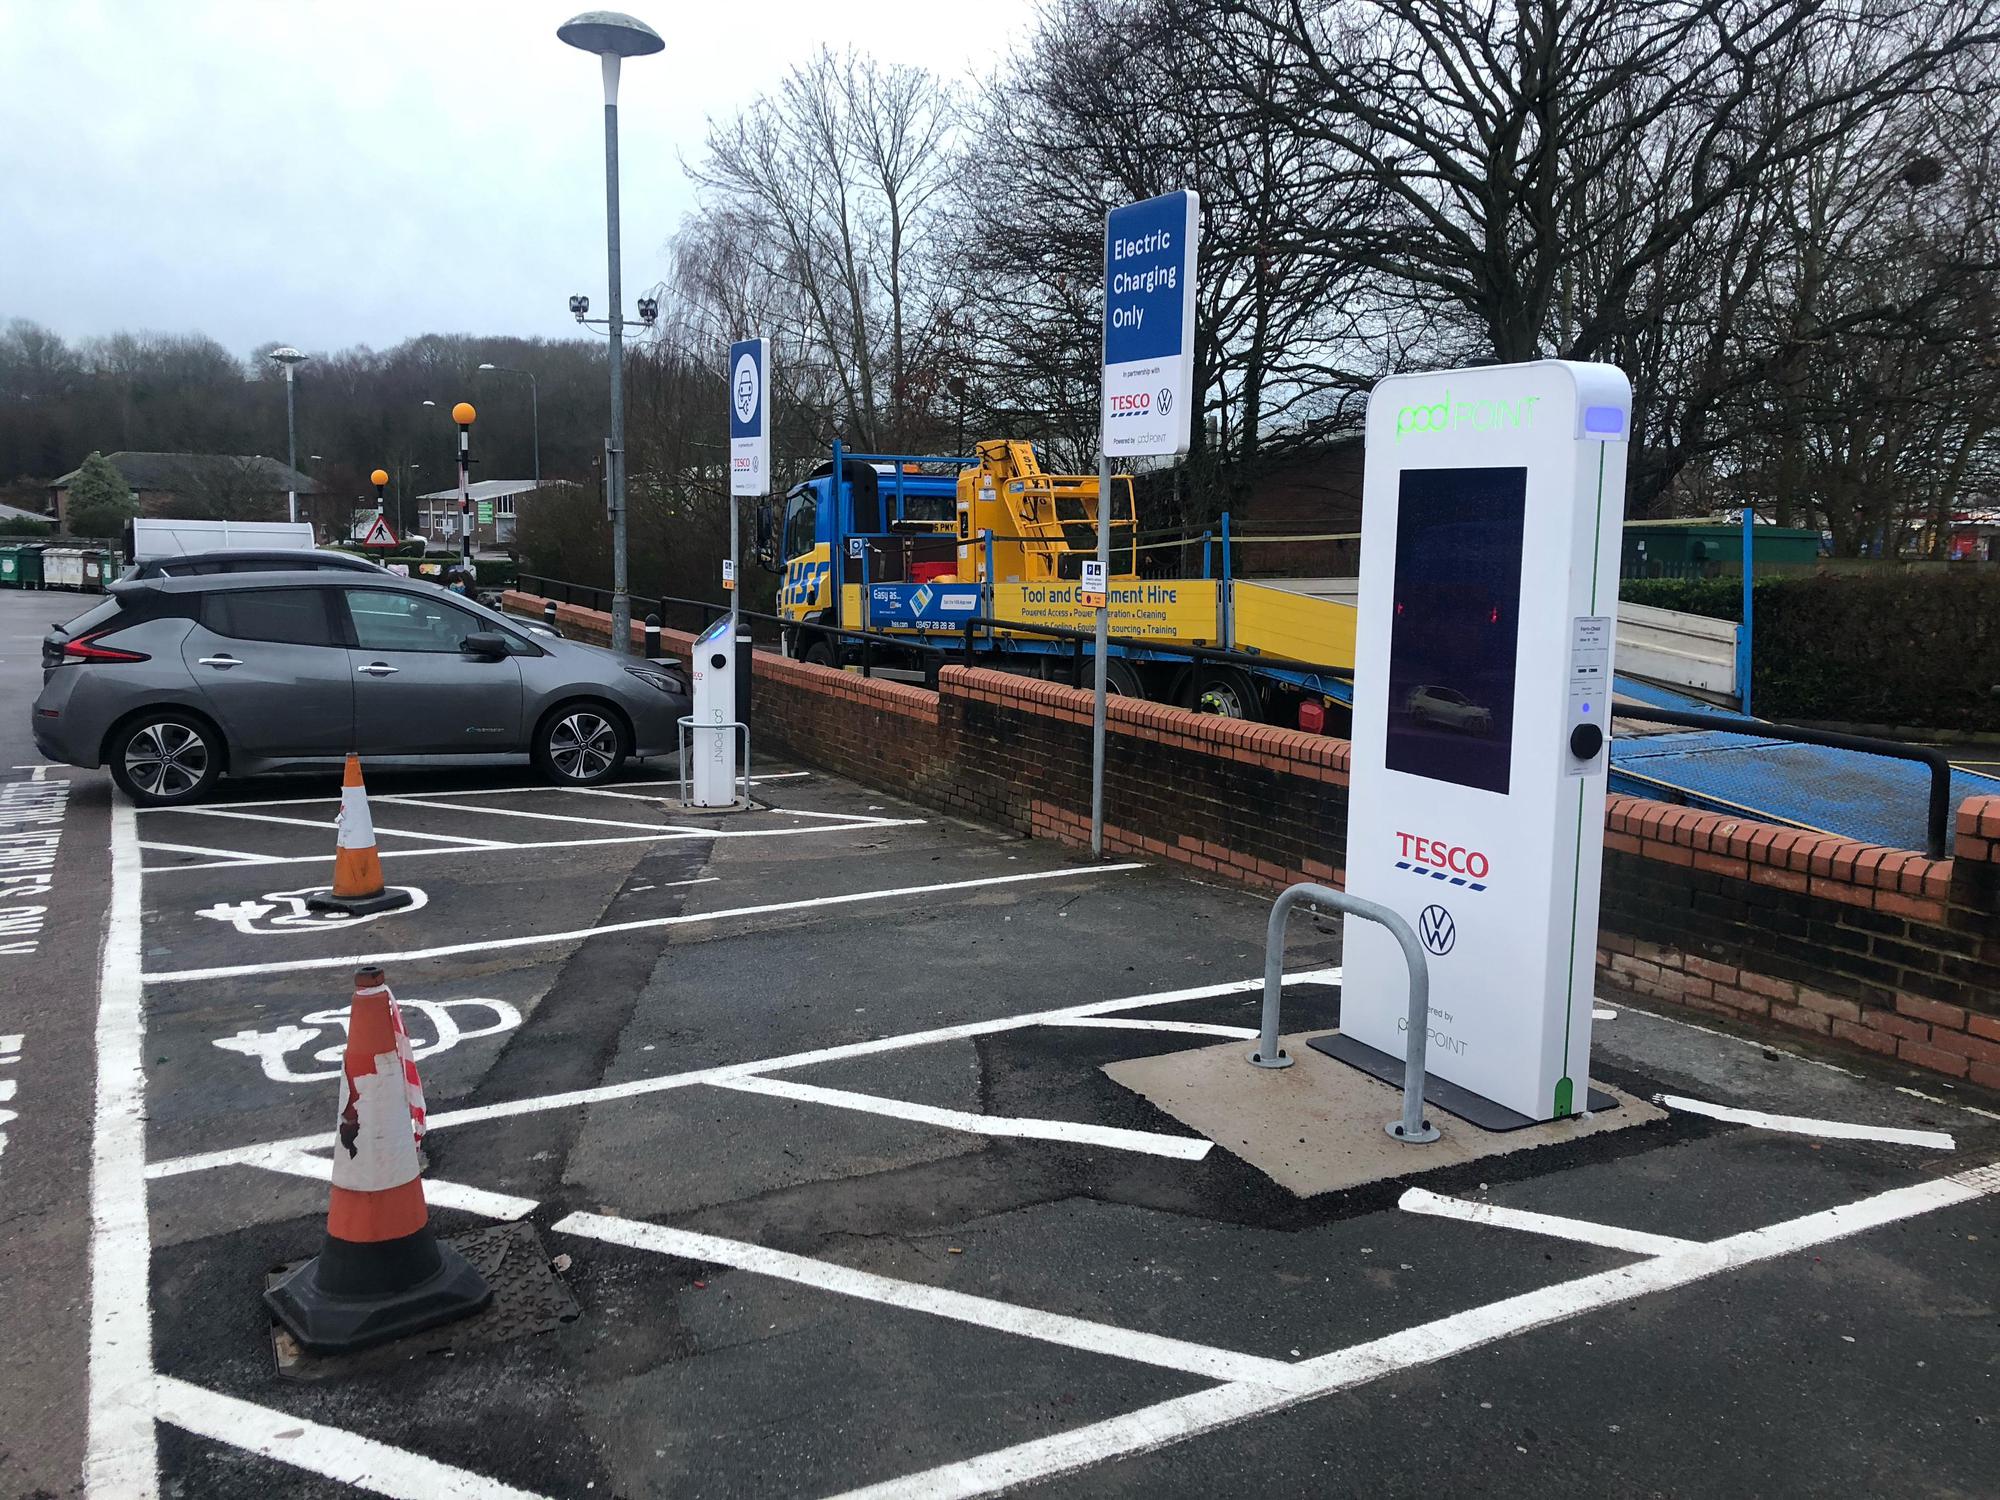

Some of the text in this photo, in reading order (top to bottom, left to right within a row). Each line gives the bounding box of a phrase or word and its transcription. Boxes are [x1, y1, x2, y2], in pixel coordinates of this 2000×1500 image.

[1115, 229, 1170, 261] Electric
[1113, 265, 1176, 295] Charging
[1113, 304, 1144, 330] Only
[1127, 368, 1151, 378] partnership
[1110, 393, 1151, 411] TESCO
[1452, 396, 1541, 433] POINT
[733, 457, 751, 468] TESCO
[785, 562, 831, 605] HSS
[873, 589, 888, 601] Easy
[1021, 586, 1046, 603] Tool
[1049, 586, 1071, 603] and
[1147, 585, 1177, 604] Hire
[1021, 608, 1047, 617] Powered
[1047, 608, 1069, 617] Access
[1073, 608, 1094, 618] Power
[1136, 609, 1167, 621] Cleaning
[1111, 624, 1141, 635] sourcing
[1147, 624, 1177, 637] Training
[1396, 831, 1489, 879] TESCO
[1444, 1010, 1454, 1024] by
[1427, 1027, 1469, 1057] POINT
